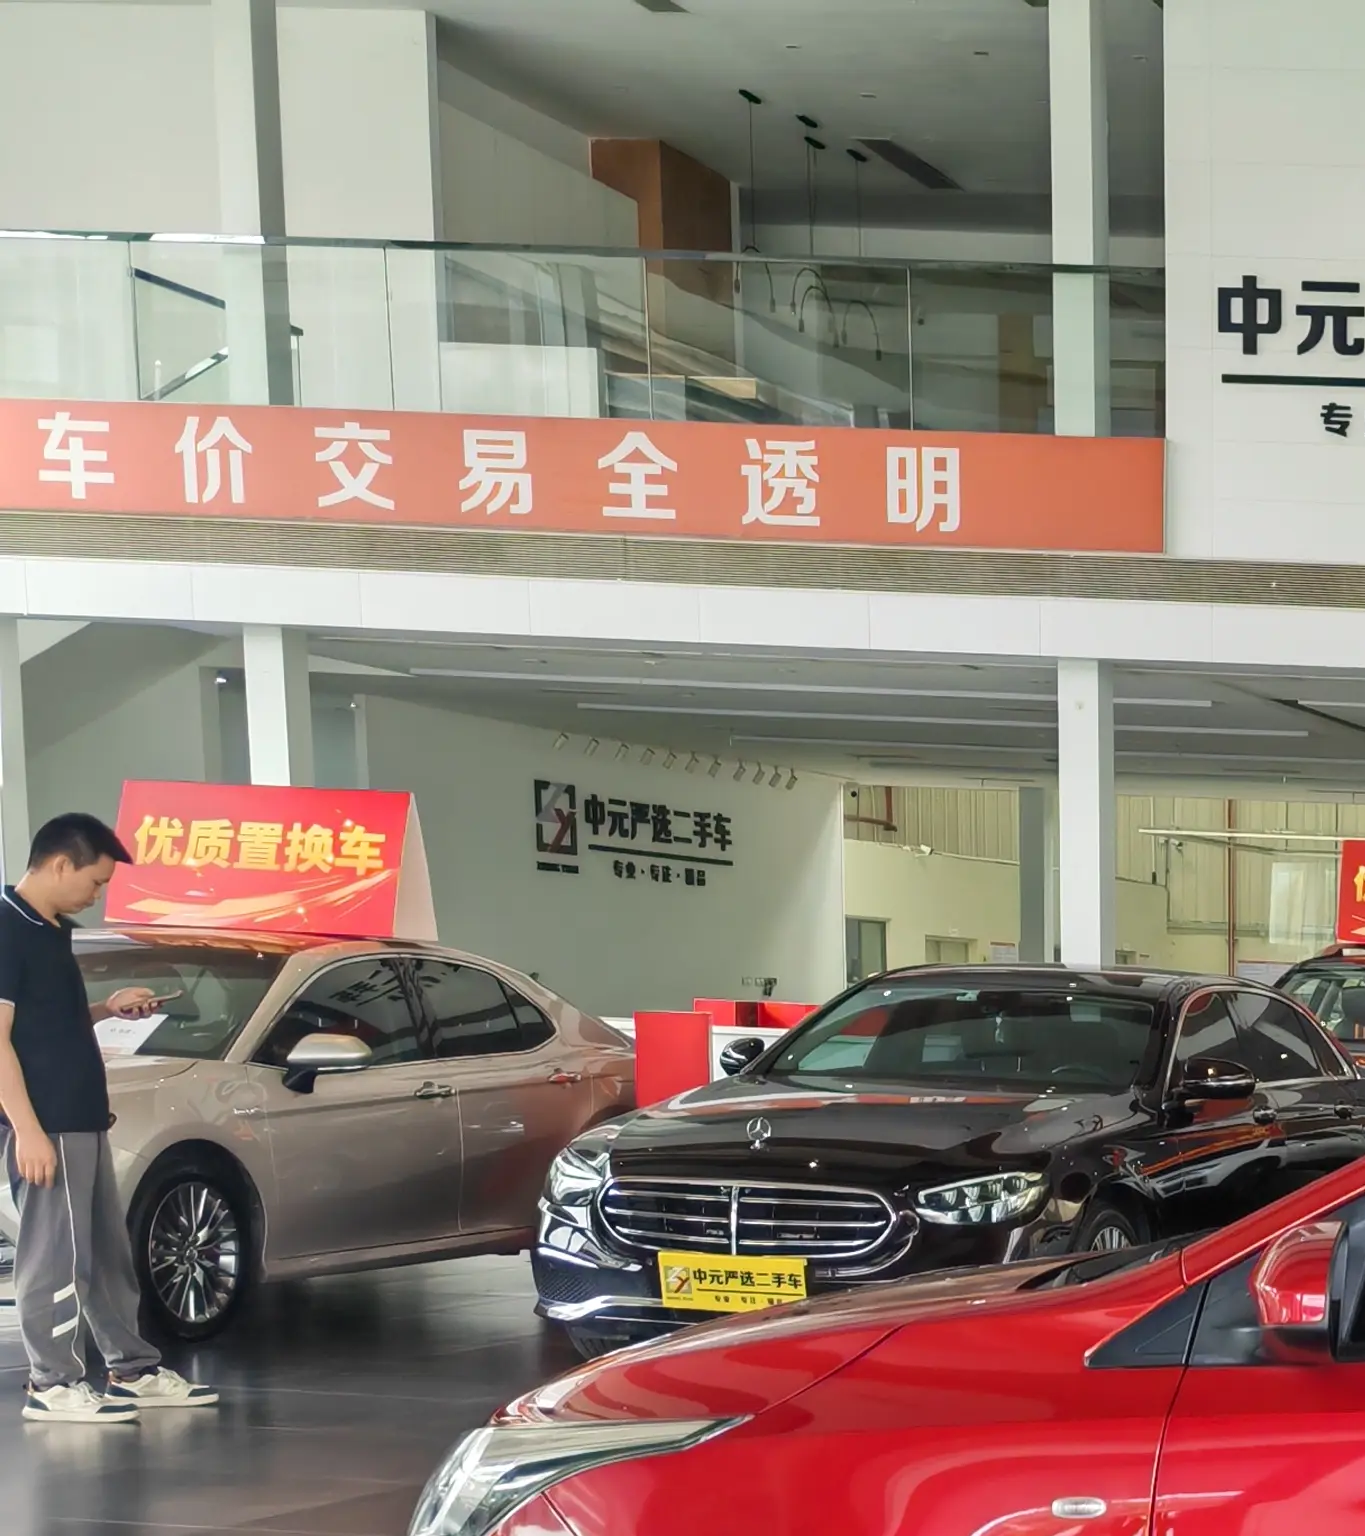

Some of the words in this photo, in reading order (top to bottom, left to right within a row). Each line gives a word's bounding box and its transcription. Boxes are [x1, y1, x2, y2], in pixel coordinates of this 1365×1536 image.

[37, 411, 962, 533] 车价交易全透明
[134, 815, 387, 876] 优质置换车
[584, 794, 733, 852] 中元严选二手车
[692, 1267, 803, 1290] 中元严选二手车
